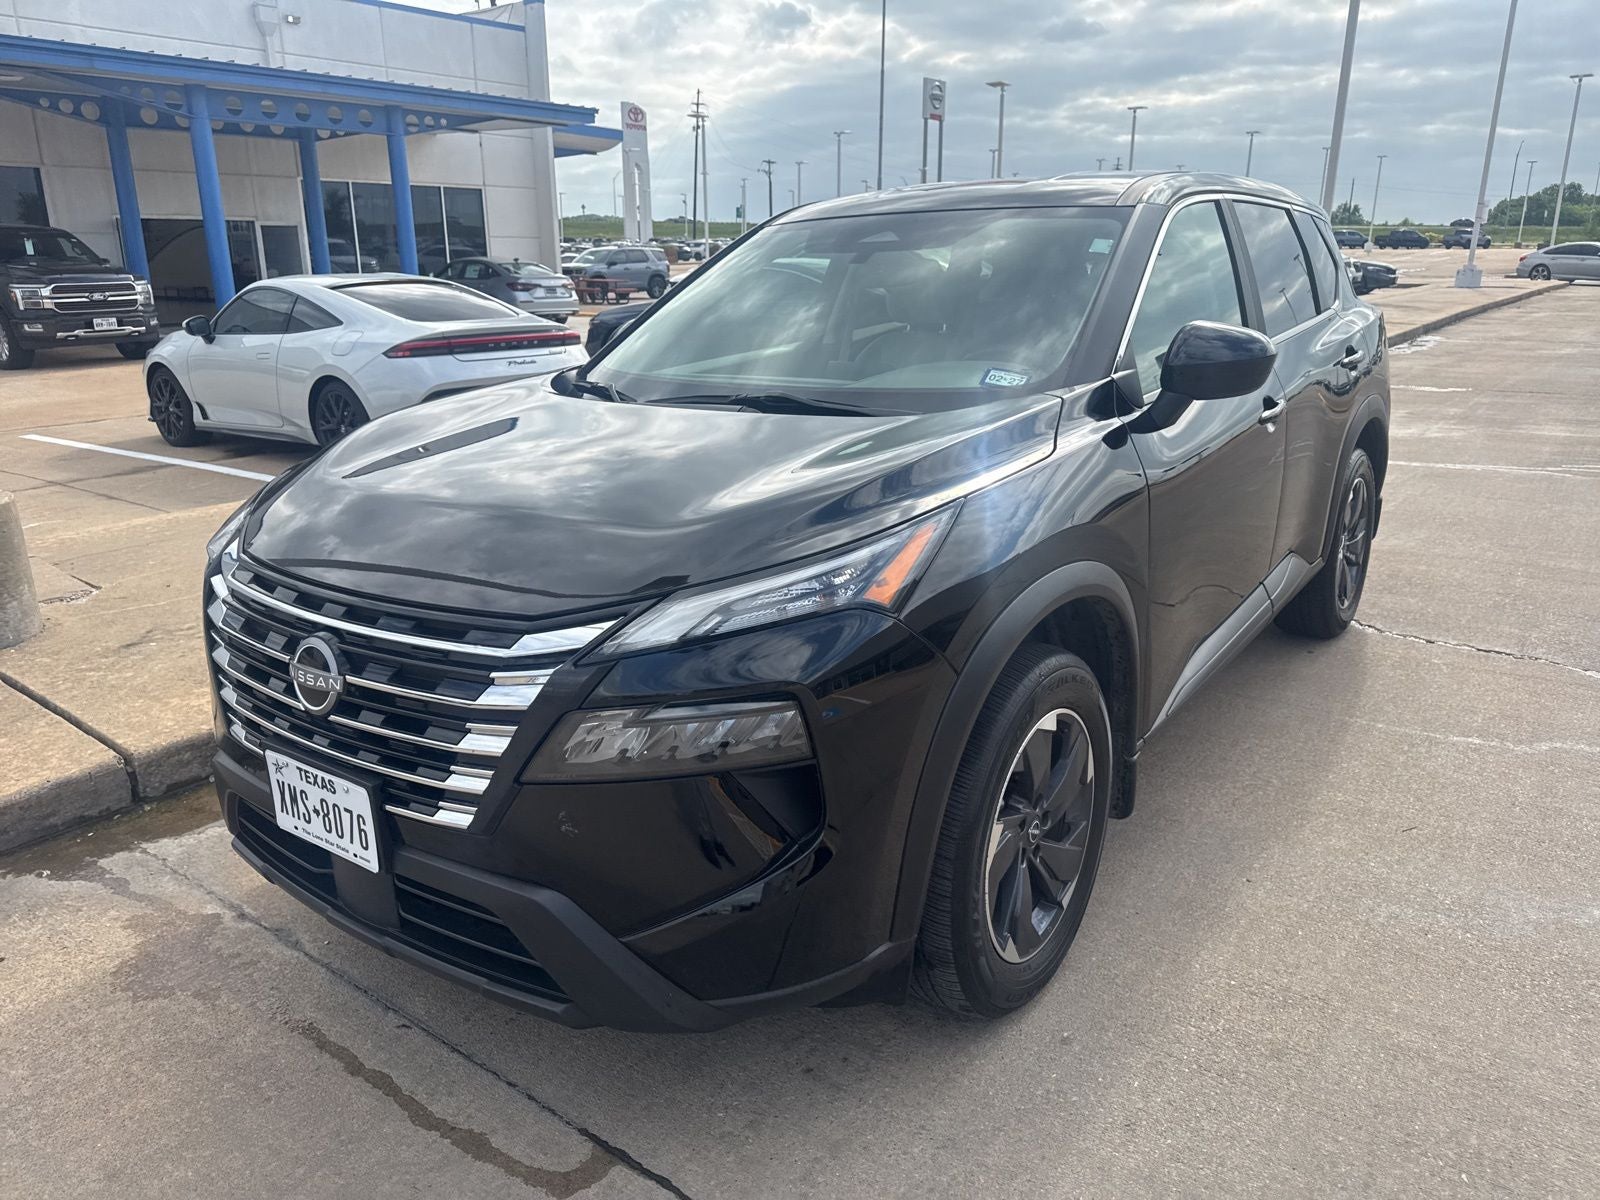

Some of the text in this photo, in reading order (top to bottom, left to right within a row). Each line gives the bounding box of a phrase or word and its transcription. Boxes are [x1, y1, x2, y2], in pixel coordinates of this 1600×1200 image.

[289, 663, 341, 691] NISSAN
[296, 766, 337, 795] TEXAS
[302, 827, 349, 853] The Lone Star State
